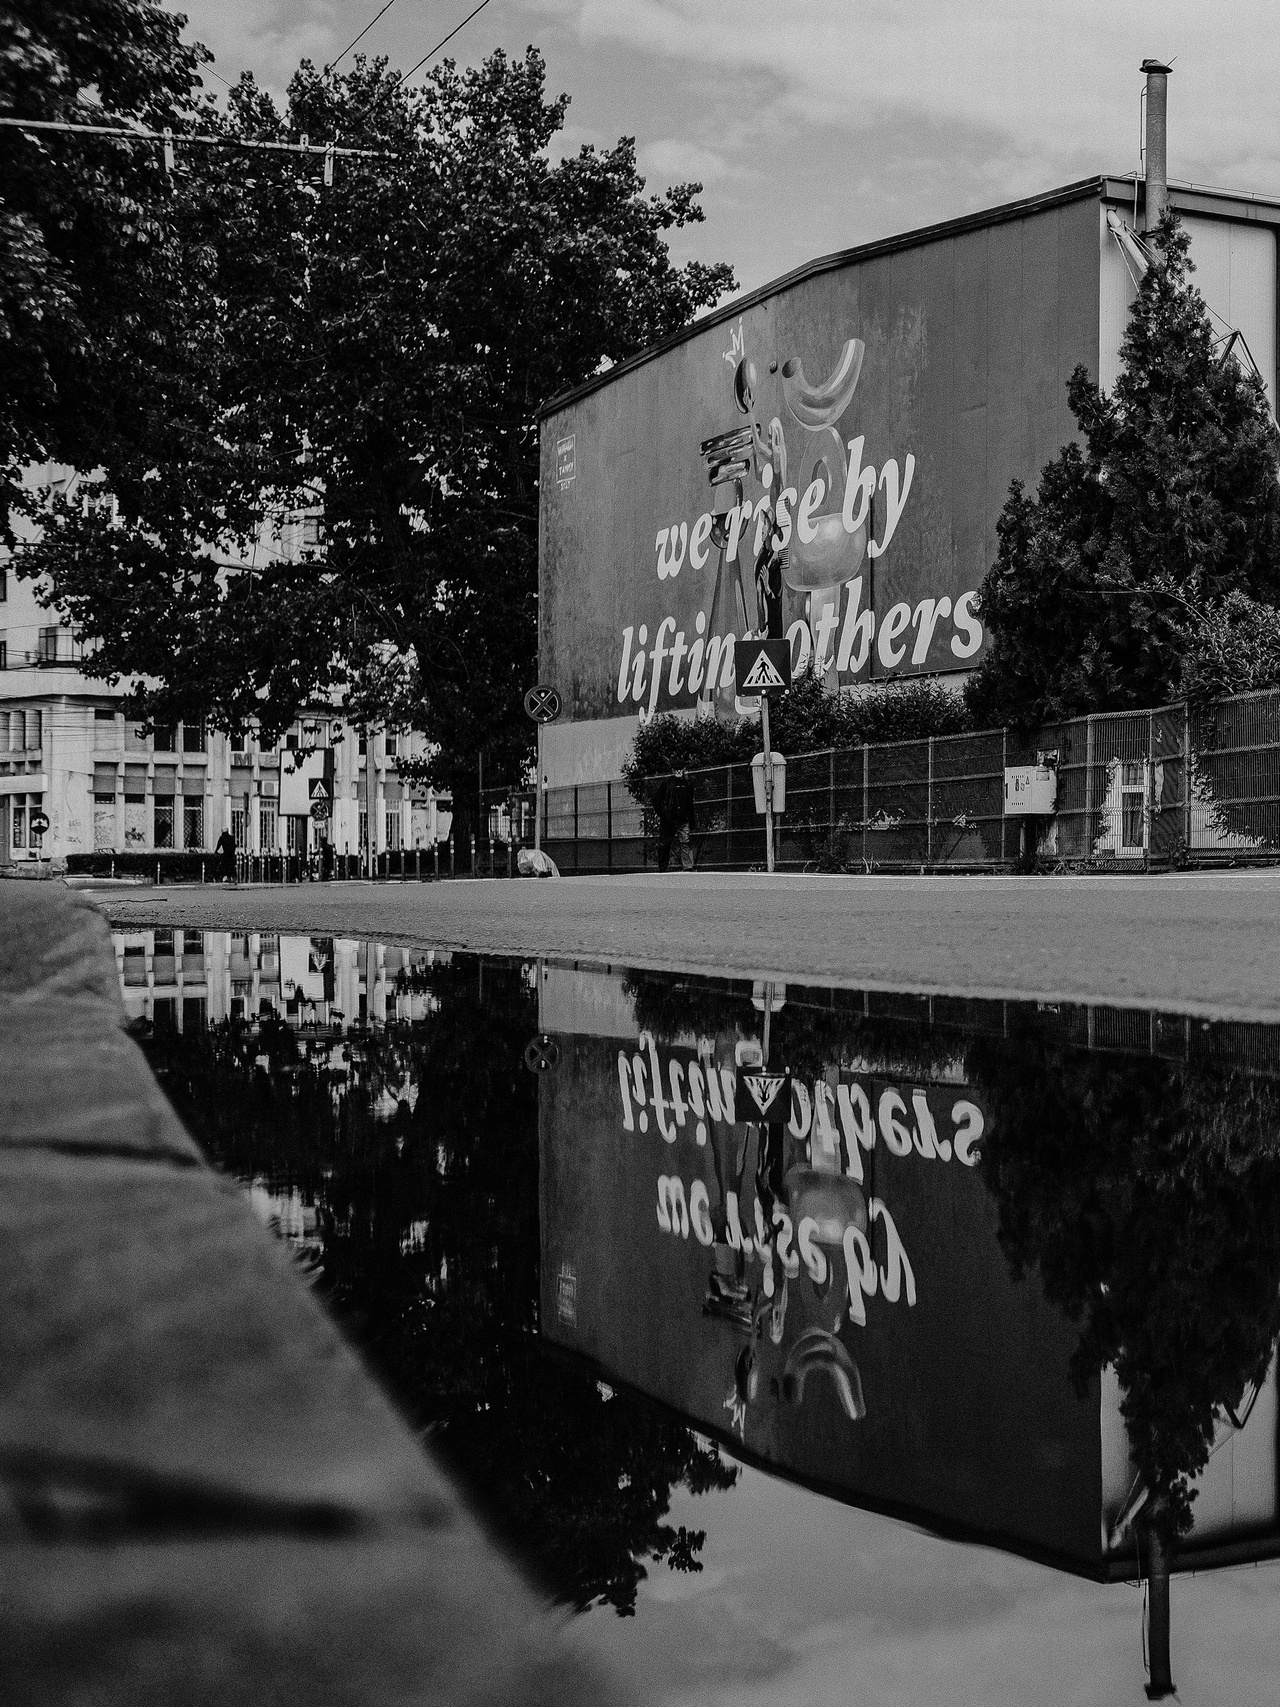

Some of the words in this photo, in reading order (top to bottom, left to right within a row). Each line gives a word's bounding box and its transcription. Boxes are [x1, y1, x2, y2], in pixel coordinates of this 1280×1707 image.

[655, 513, 713, 580] we
[725, 463, 826, 562] rise
[842, 435, 916, 558] by
[784, 576, 983, 679] others
